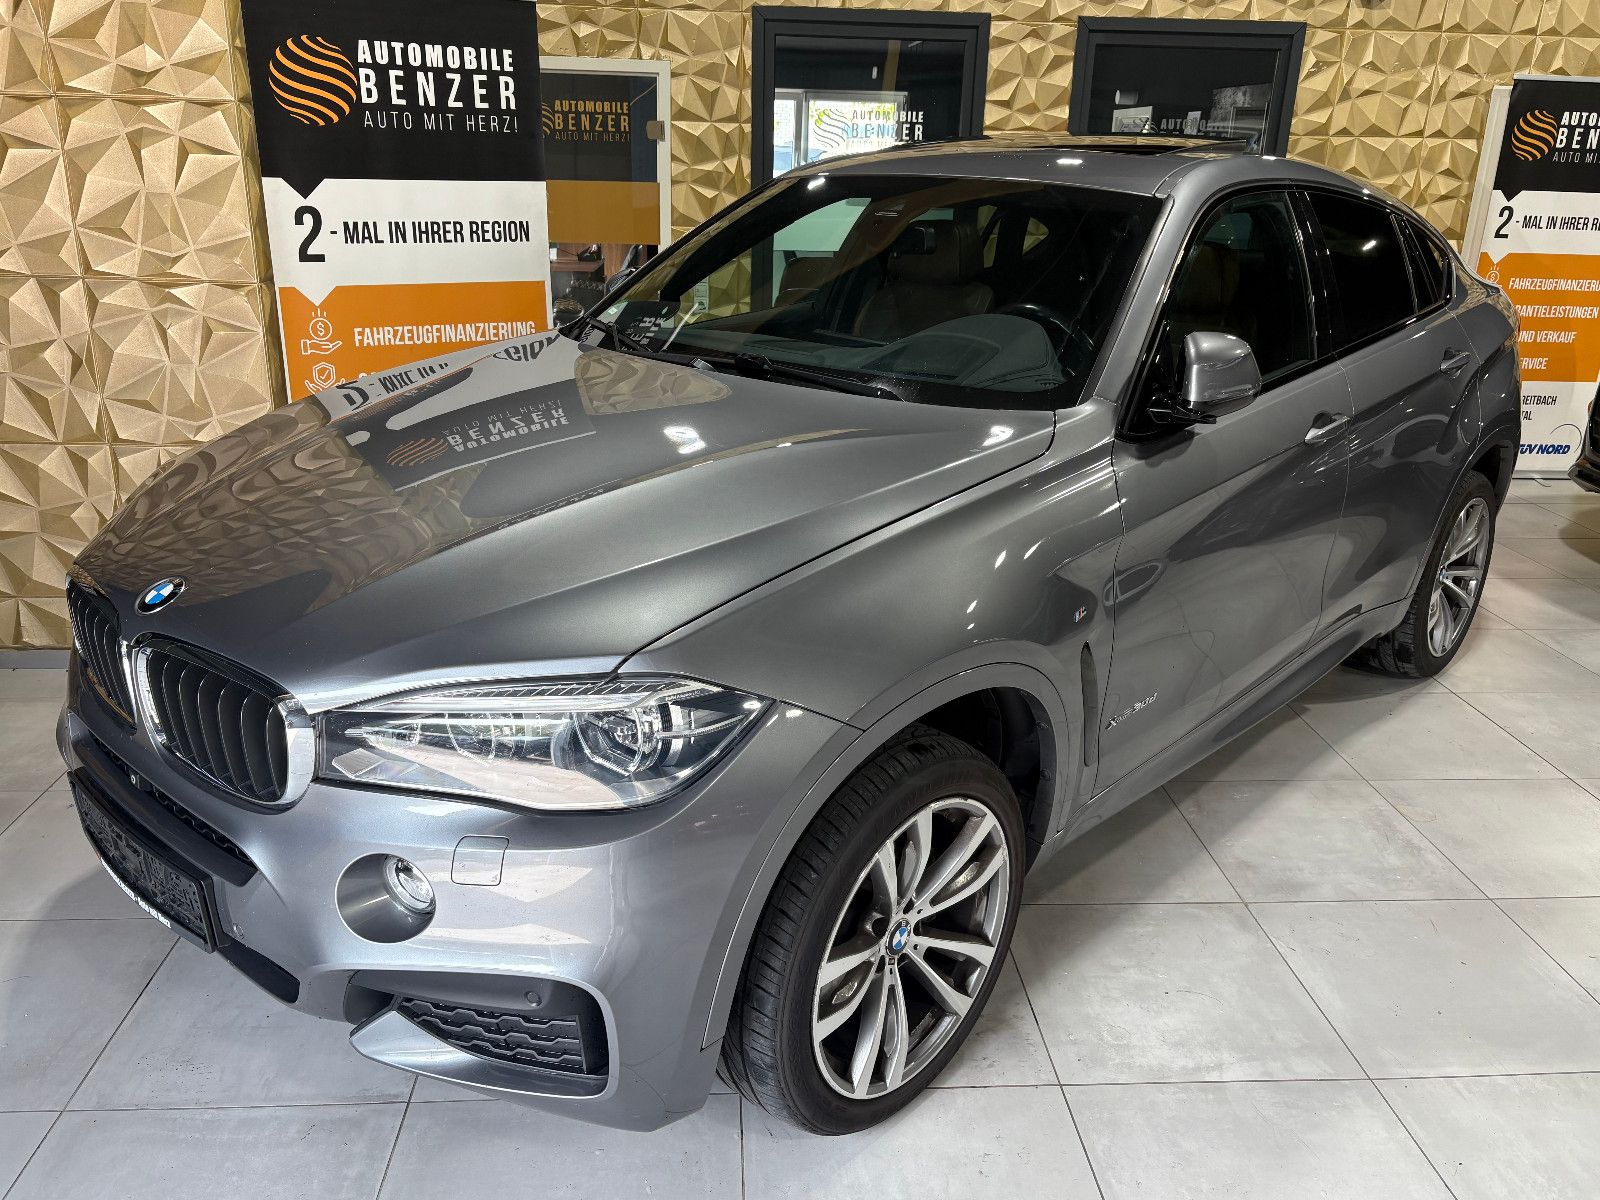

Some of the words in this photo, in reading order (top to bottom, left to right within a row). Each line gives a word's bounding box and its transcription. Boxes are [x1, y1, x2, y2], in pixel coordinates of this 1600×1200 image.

[357, 39, 514, 72] AUTOMOBILE
[358, 68, 517, 110] BENZER
[554, 99, 629, 114] AUTOMOBILE
[364, 111, 413, 130] AUTO
[424, 112, 455, 131] MIT
[466, 114, 518, 133] HERZ!
[554, 113, 630, 132] BENZER
[1560, 111, 1600, 127] AUTO
[1552, 151, 1581, 163] AUTO
[1585, 153, 1600, 164] MI
[1493, 205, 1514, 239] 2
[1521, 215, 1544, 230] MAL
[1545, 215, 1558, 230] IN
[1558, 216, 1589, 231] IHRER
[294, 205, 326, 263] 2
[343, 221, 385, 244] MAL
[388, 221, 408, 244] IN
[412, 221, 465, 244] IHRER
[469, 220, 531, 243] REGION
[353, 320, 537, 347] FAHRZEUGFINANZIERUNG
[1536, 331, 1578, 344] VERKAUF
[1536, 443, 1571, 455] NORD
